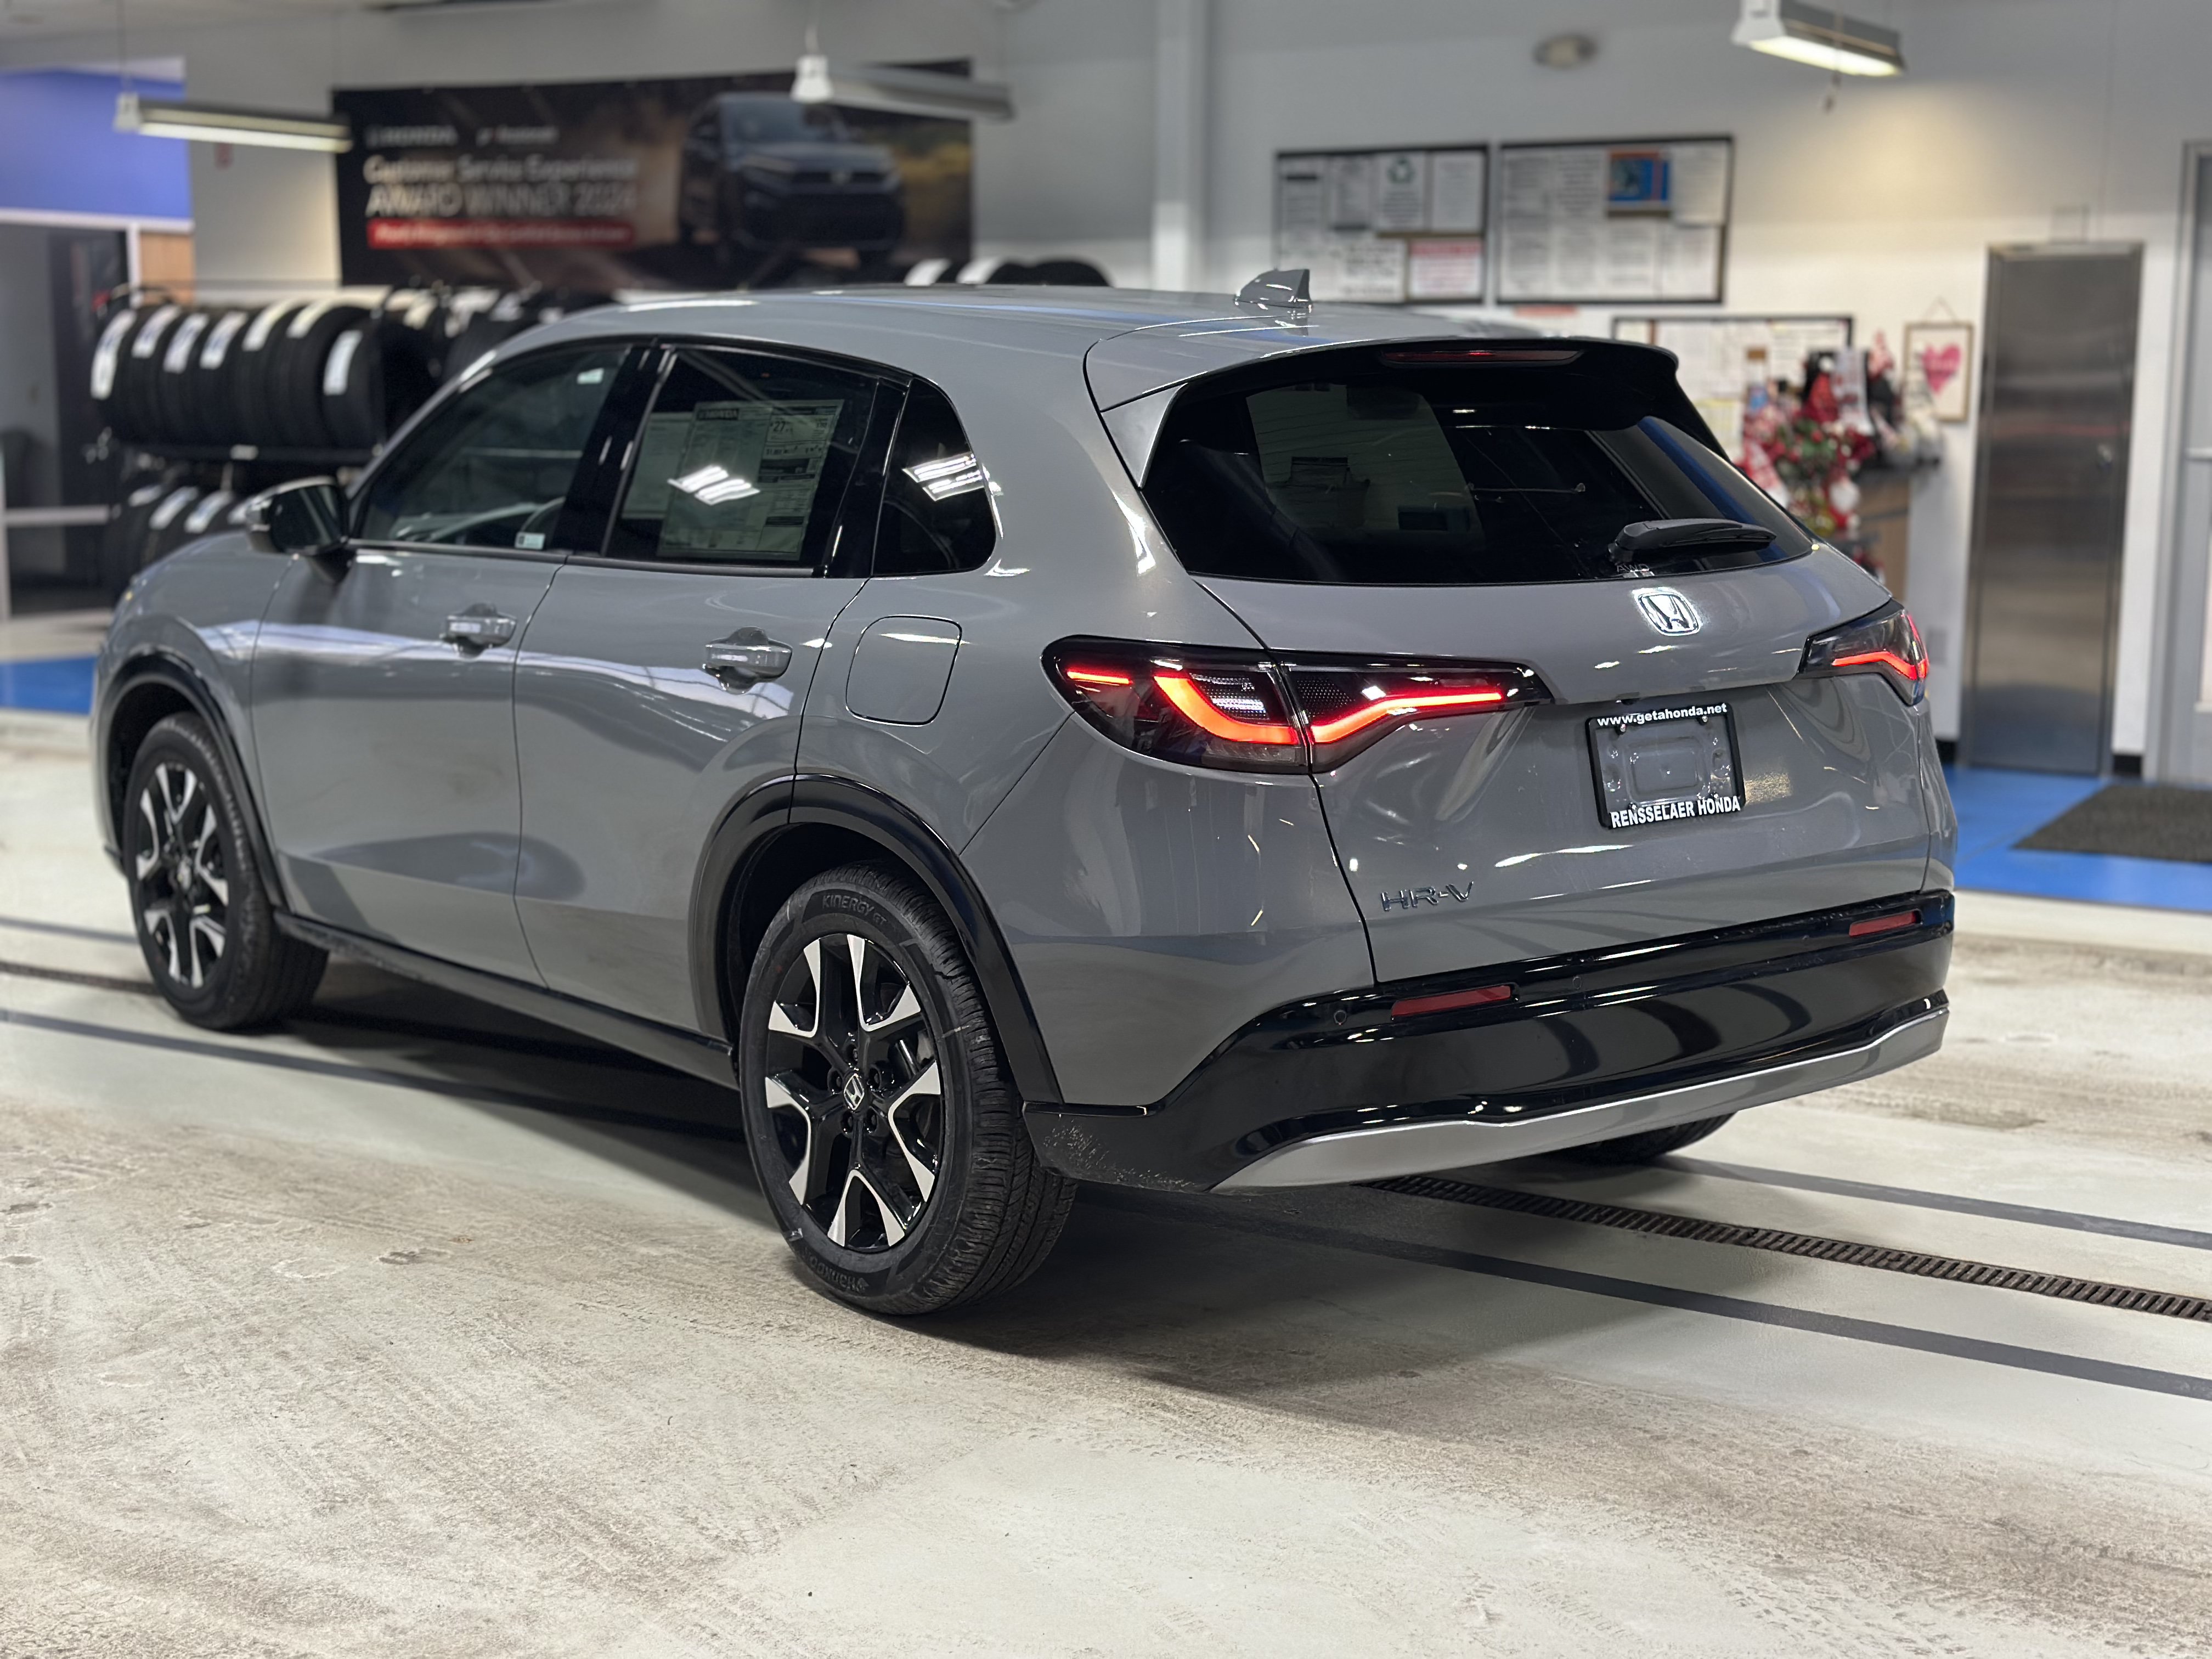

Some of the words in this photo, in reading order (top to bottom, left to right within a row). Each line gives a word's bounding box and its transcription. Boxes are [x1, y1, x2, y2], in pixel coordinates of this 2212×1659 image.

[1616, 563, 1650, 573] AWD
[1597, 703, 1728, 726] www.getahonda.net
[1611, 802, 1695, 828] RENSSELAER
[1697, 795, 1741, 816] HONDA
[1381, 881, 1475, 912] HR-V
